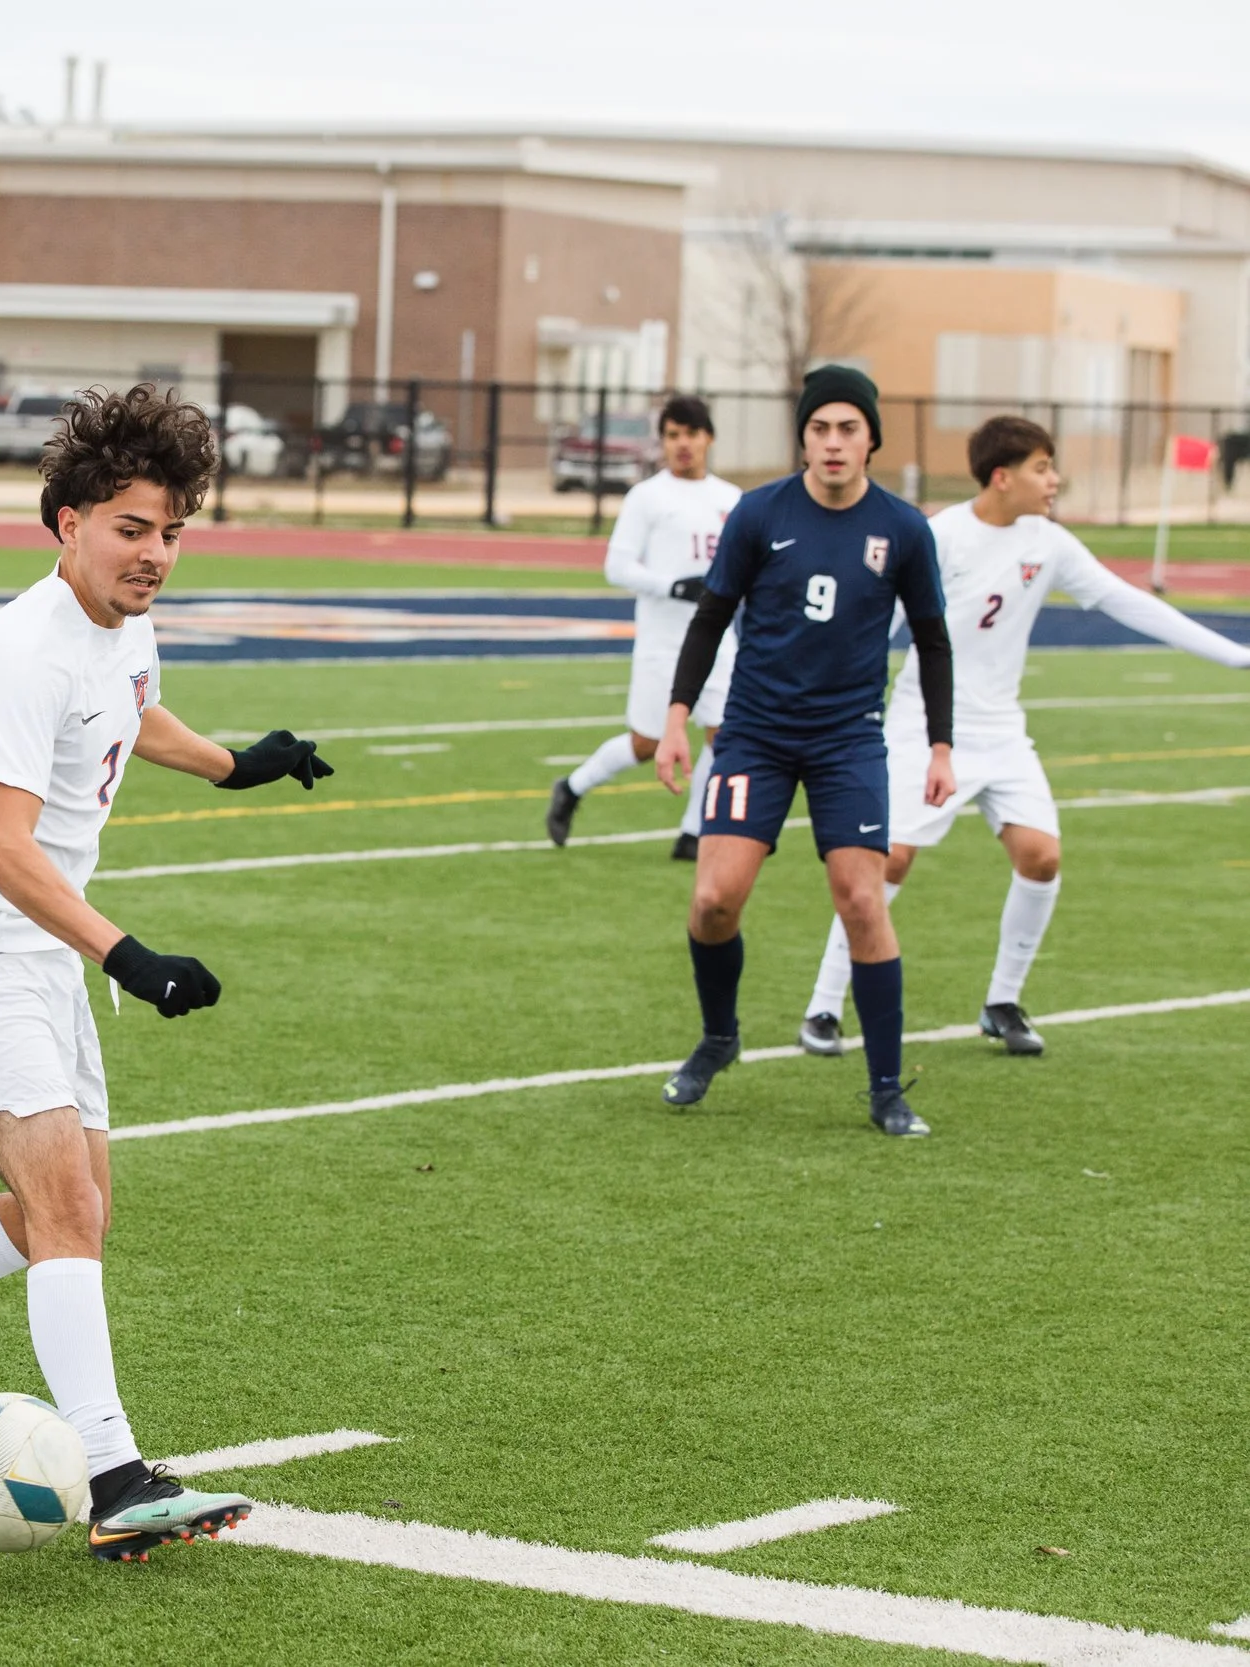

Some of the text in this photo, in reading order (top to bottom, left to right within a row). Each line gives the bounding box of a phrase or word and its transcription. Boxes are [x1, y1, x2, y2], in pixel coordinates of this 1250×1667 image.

[804, 574, 837, 622] 9
[978, 593, 1003, 629] 2
[705, 774, 750, 821] 11
